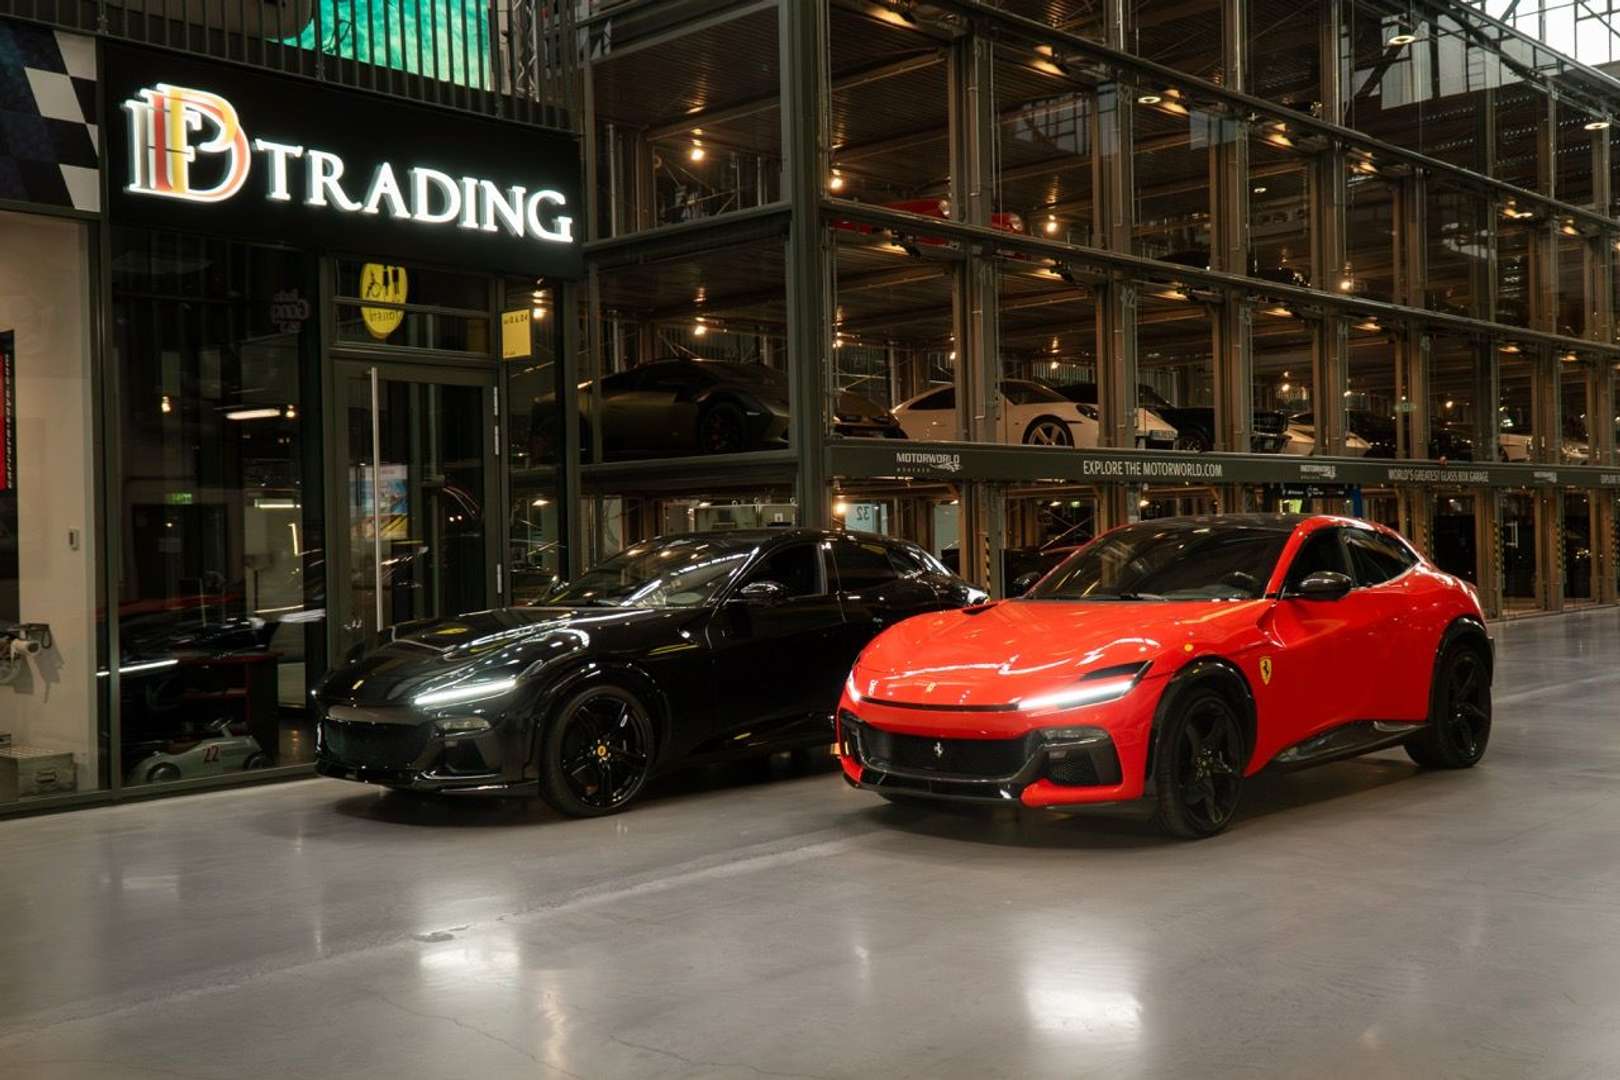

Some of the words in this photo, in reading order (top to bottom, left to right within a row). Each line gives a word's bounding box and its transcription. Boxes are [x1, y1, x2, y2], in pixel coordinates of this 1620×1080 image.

[253, 136, 574, 244] TRADING
[896, 452, 960, 464] MOTORWORLD
[1083, 460, 1123, 475] EXPLORE
[1125, 461, 1142, 475] THE
[1143, 462, 1223, 477] MOTORWORLD.COM
[202, 745, 219, 763] 22
